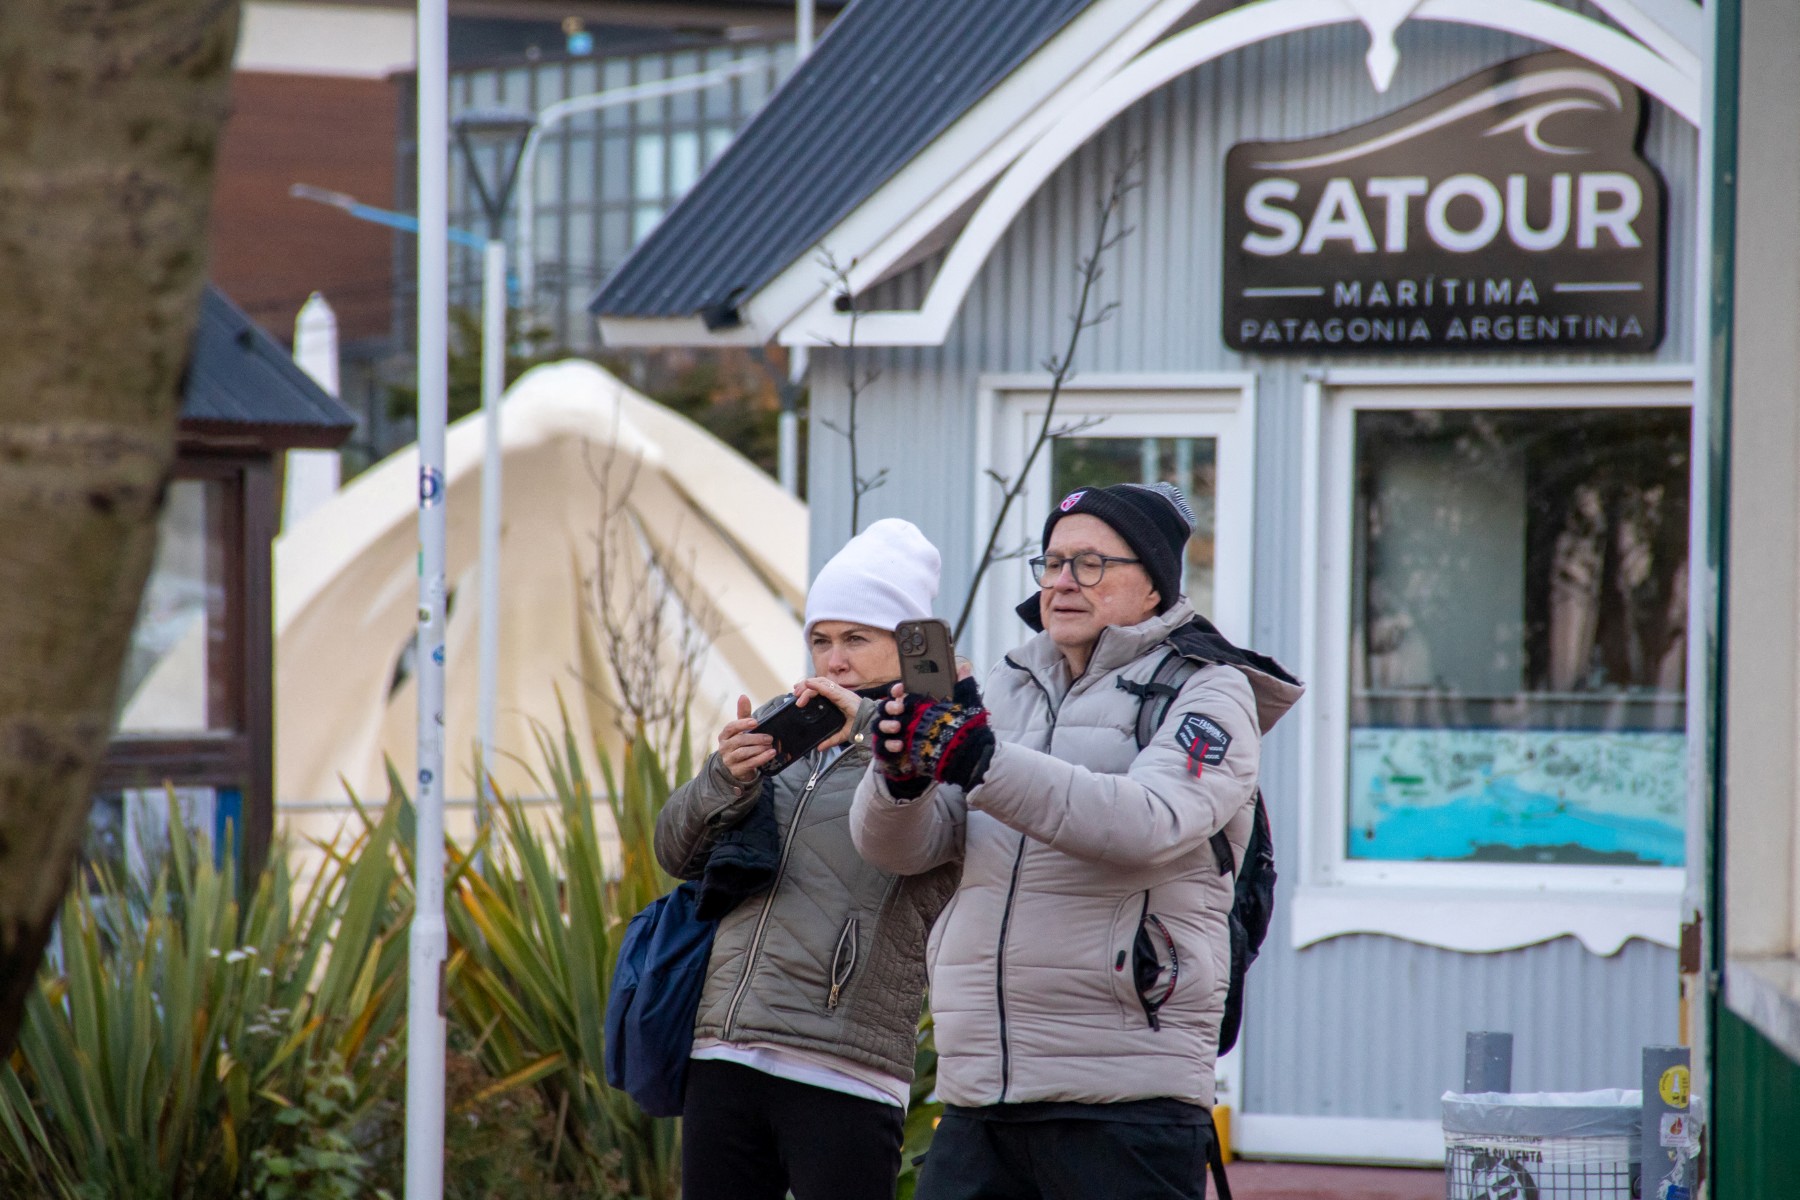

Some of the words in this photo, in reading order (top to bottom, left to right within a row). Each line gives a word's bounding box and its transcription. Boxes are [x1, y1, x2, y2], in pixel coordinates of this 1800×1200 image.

[1241, 173, 1643, 255] SATOUR
[1334, 275, 1539, 308] MARÍTIMA
[1241, 318, 1430, 343] PATAGONIA
[1446, 315, 1643, 341] ARGENTINA
